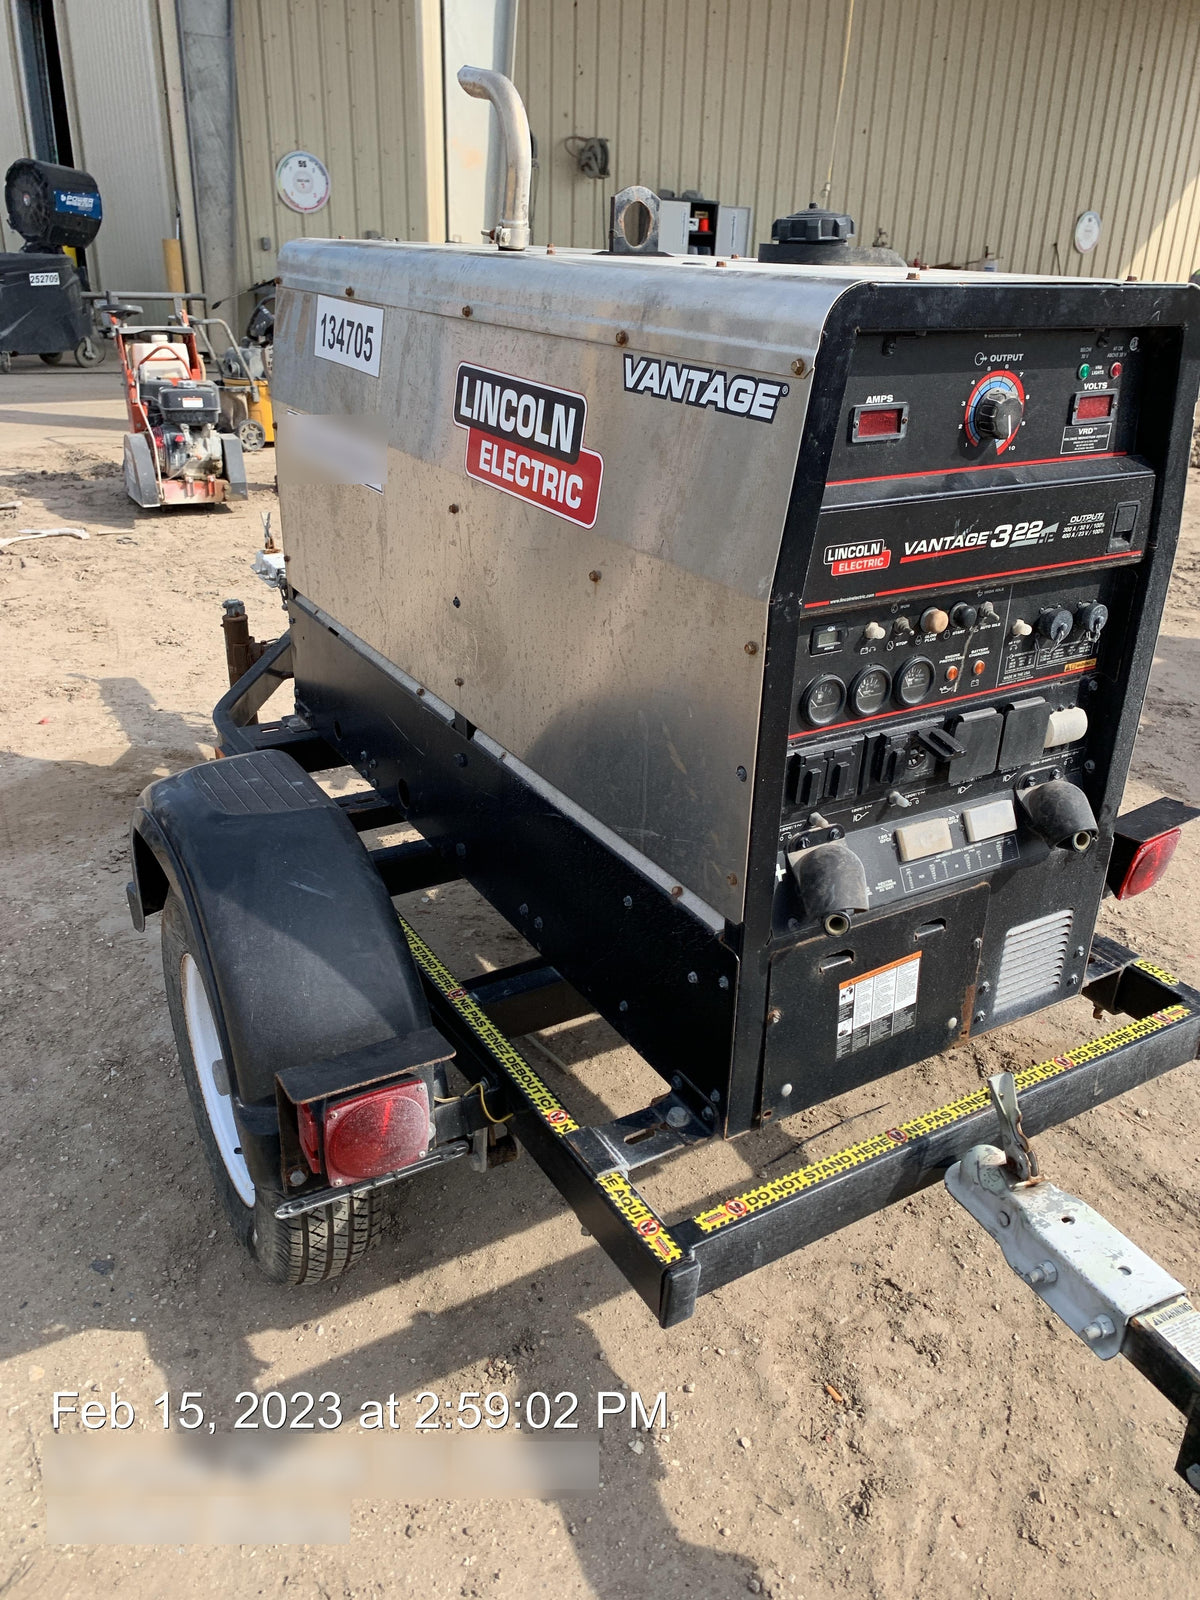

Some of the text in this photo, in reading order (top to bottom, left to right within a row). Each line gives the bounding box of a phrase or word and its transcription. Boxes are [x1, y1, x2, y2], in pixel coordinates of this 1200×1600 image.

[30, 274, 59, 284] 252709
[321, 313, 374, 362] 134705
[989, 353, 1024, 363] OUTPUT
[1083, 382, 1108, 390] VOLTS
[865, 395, 894, 404] AMPS
[460, 375, 577, 454] LINCOLN
[478, 439, 584, 510] ELECTRIC
[1069, 513, 1103, 523] OUTPUT
[990, 520, 1044, 548] 322
[827, 542, 881, 561] LINCOLN
[838, 557, 885, 572] ELECTRIC
[413, 945, 438, 970] STAND
[435, 970, 456, 991] HERE
[460, 999, 554, 1110] NE PAS TENEZ DEBOUT ICI
[745, 1191, 771, 1207] DO
[771, 1176, 804, 1195] NOT
[803, 1154, 853, 1180] STAND
[853, 1138, 892, 1159] HERE
[905, 1122, 925, 1135] NE
[924, 1111, 952, 1126] PAS
[951, 1092, 990, 1112] TENEZ
[1041, 1064, 1059, 1076] ICI
[1069, 1050, 1088, 1063] NO
[1087, 1044, 1103, 1054] SE
[1102, 1030, 1133, 1047] PARE
